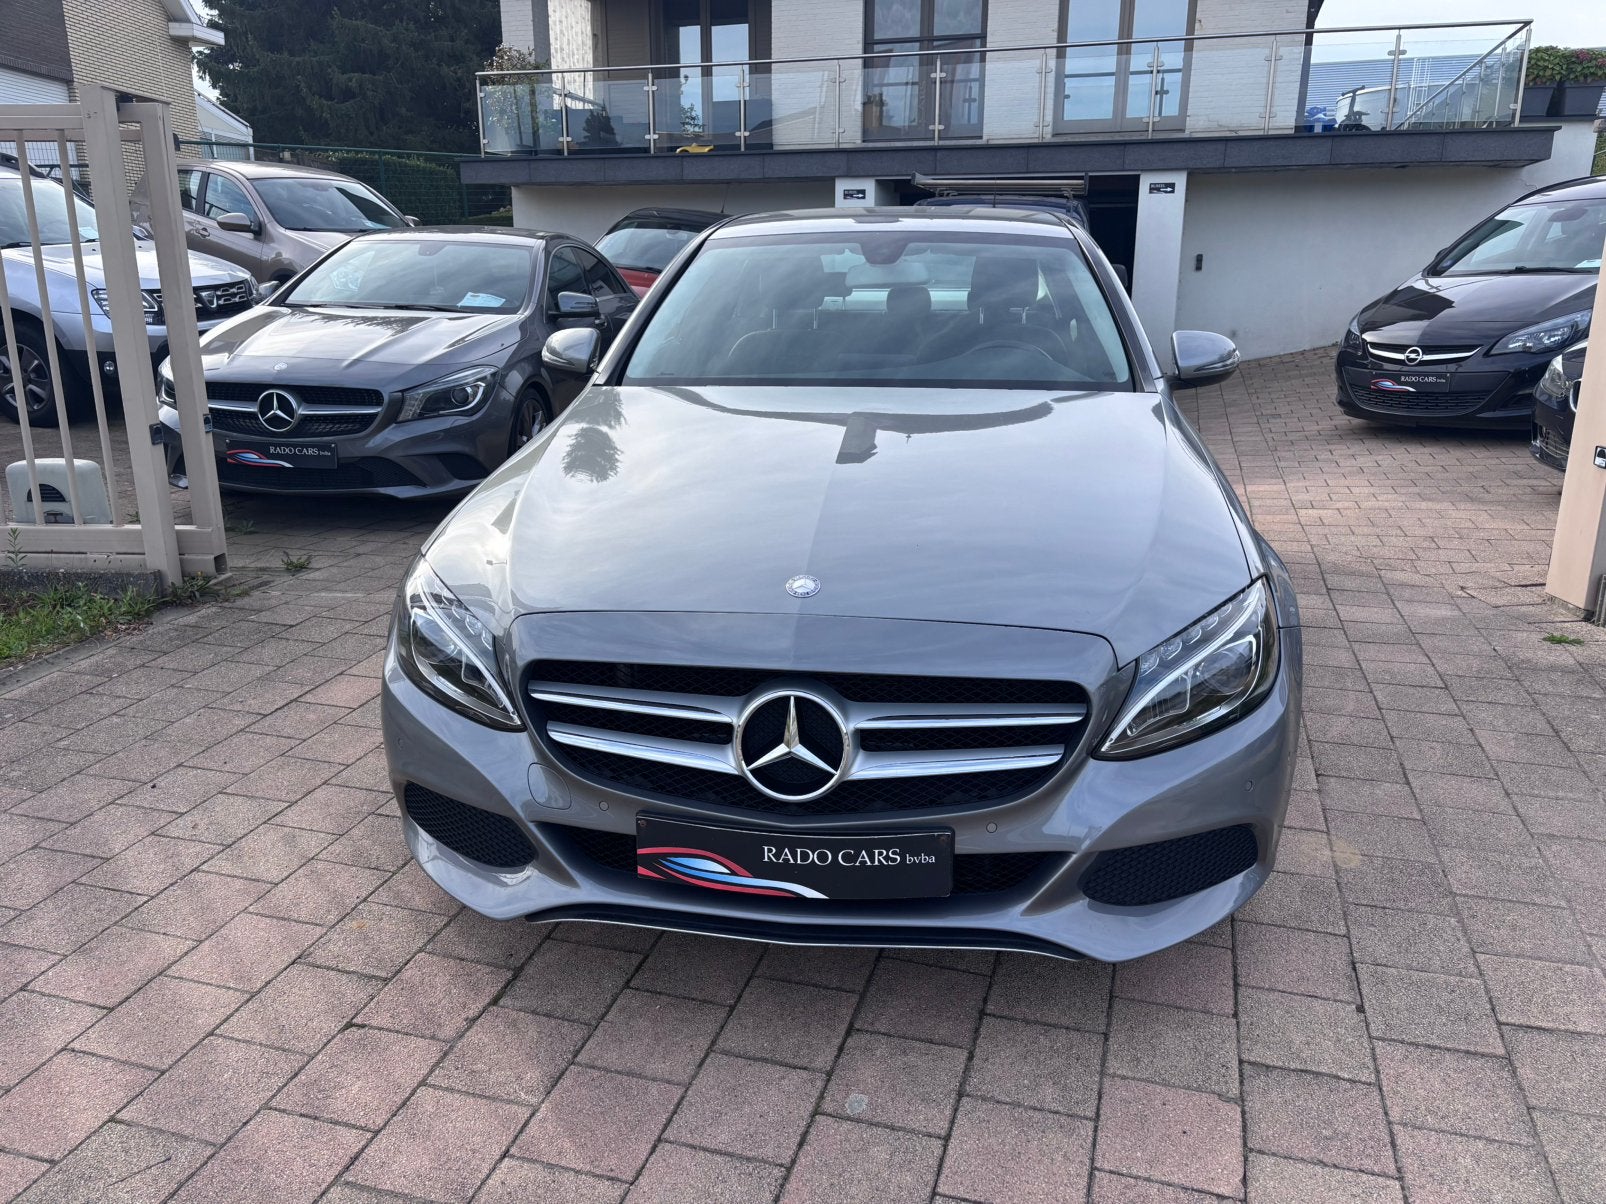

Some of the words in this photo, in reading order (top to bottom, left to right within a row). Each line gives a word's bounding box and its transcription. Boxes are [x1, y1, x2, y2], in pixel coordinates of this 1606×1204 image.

[269, 446, 295, 455] RADO
[295, 447, 319, 456] CARS
[762, 845, 832, 866] RADO
[838, 848, 901, 867] CARS
[906, 853, 936, 865] bvba
